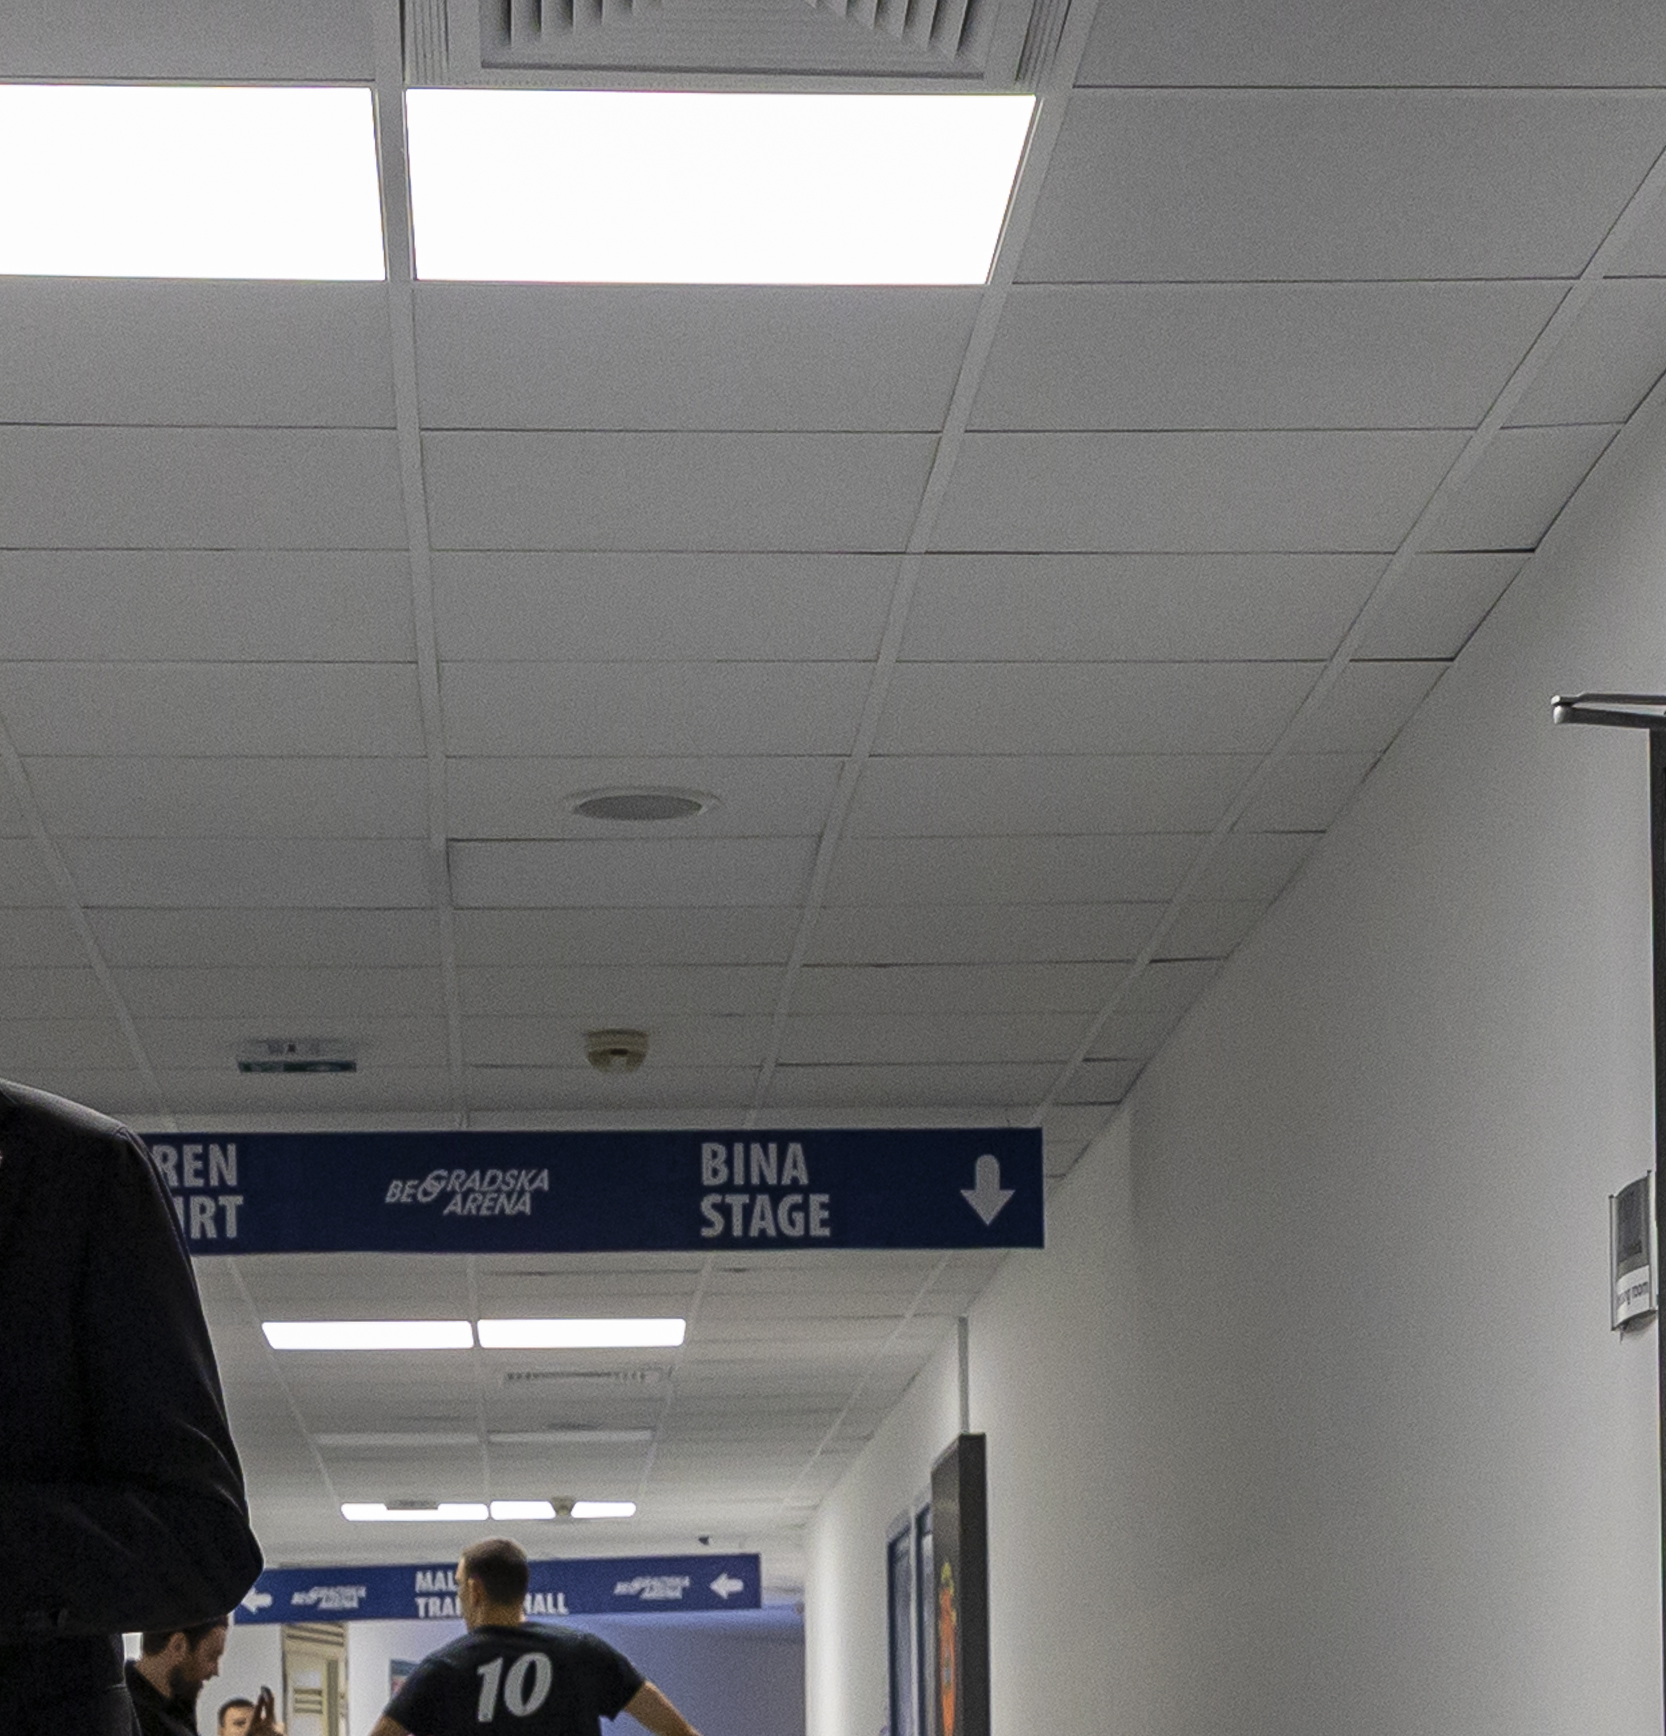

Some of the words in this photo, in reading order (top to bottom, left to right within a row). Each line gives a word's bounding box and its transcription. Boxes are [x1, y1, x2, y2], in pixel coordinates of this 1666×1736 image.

[701, 1142, 809, 1186] BINA
[442, 1191, 532, 1216] ARENA
[699, 1193, 831, 1238] STAGE
[415, 1570, 459, 1593] MAL
[477, 1651, 554, 1723] 10
